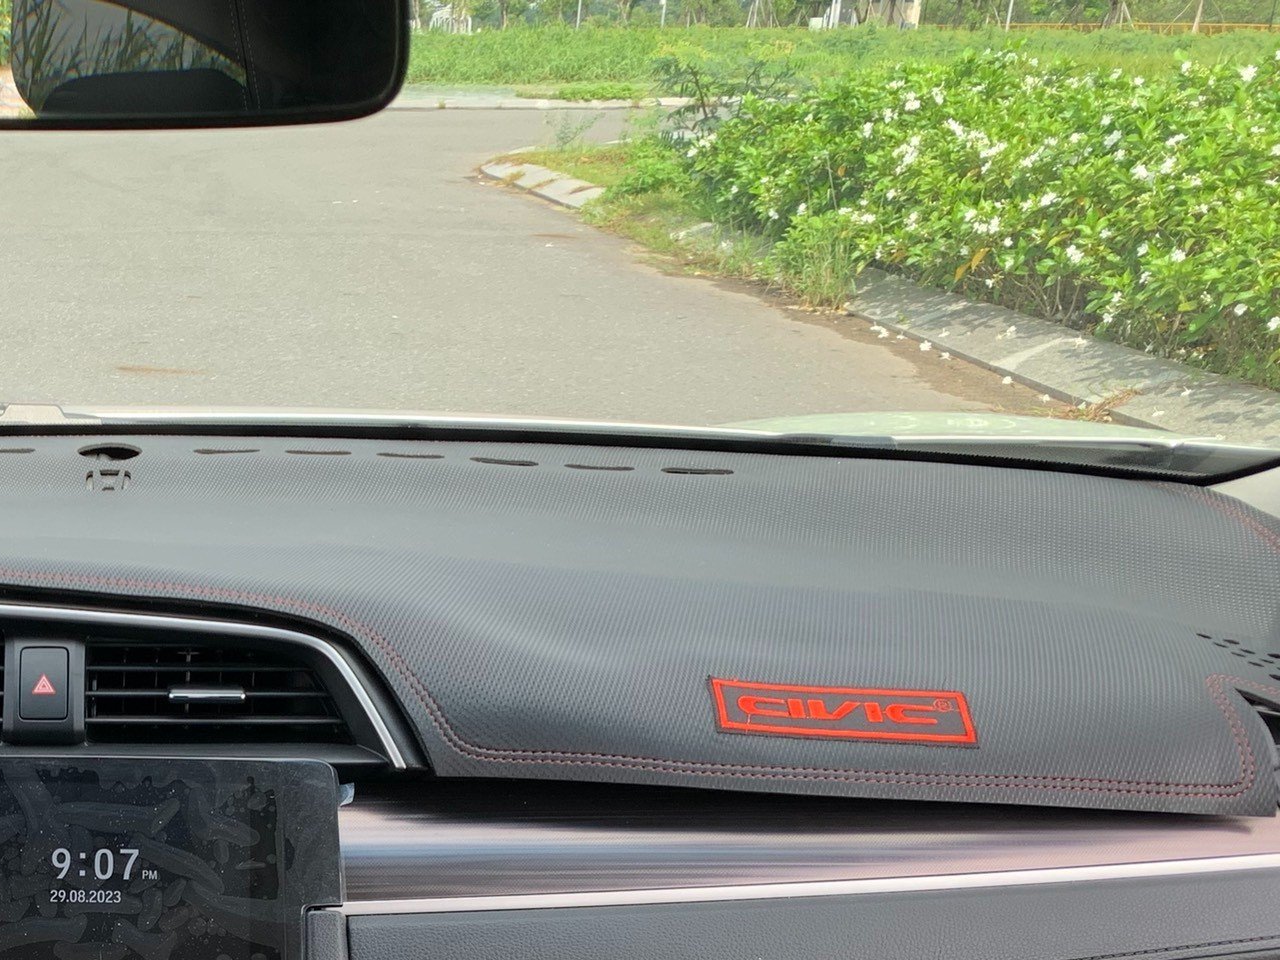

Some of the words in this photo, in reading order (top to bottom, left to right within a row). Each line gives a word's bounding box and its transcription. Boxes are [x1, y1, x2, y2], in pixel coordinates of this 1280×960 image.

[738, 695, 938, 725] CIVIC
[51, 847, 140, 880] 9:07
[142, 869, 158, 880] PM
[49, 889, 122, 904] 29.08.2023
